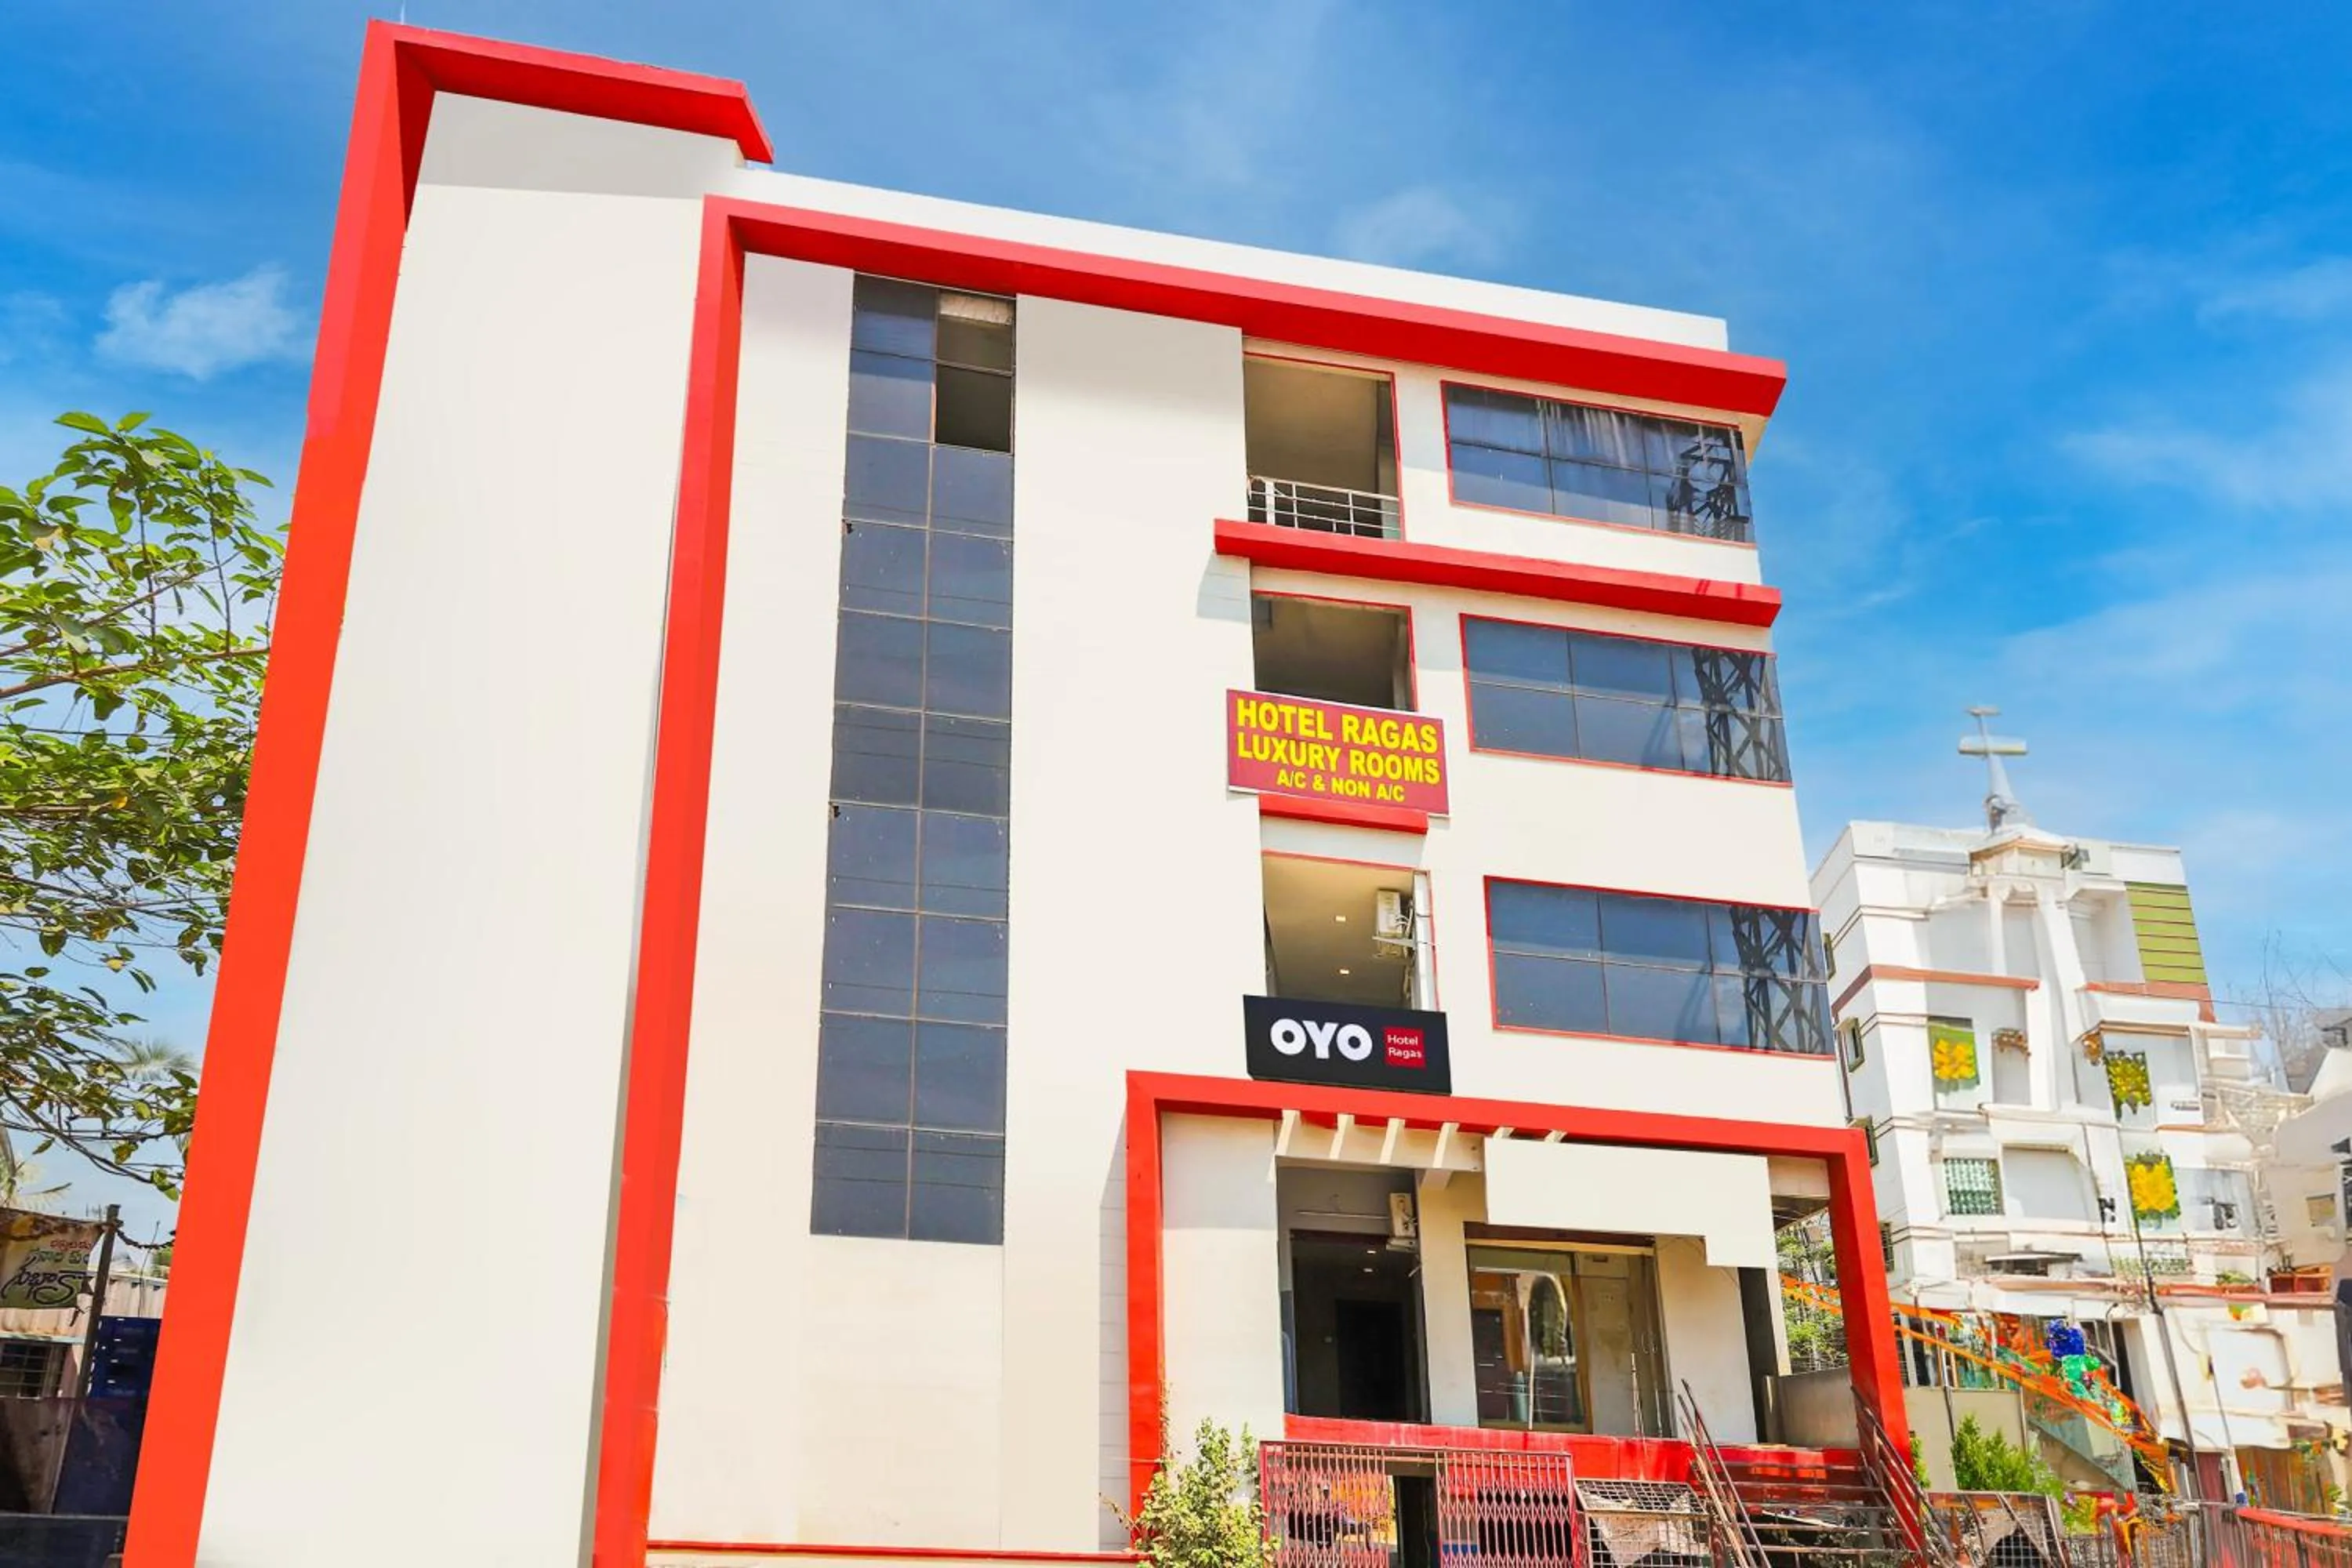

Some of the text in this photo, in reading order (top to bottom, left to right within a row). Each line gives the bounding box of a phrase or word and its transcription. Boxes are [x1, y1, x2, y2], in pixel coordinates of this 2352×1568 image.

[1236, 697, 1438, 754] HOTEL RAGAS
[1236, 731, 1441, 785] LUXURY ROOMS
[1276, 768, 1405, 803] A/C & NON A/C
[1270, 1018, 1373, 1062] OYO
[1386, 1033, 1418, 1047] Hotel
[1388, 1047, 1423, 1060] Ragas
